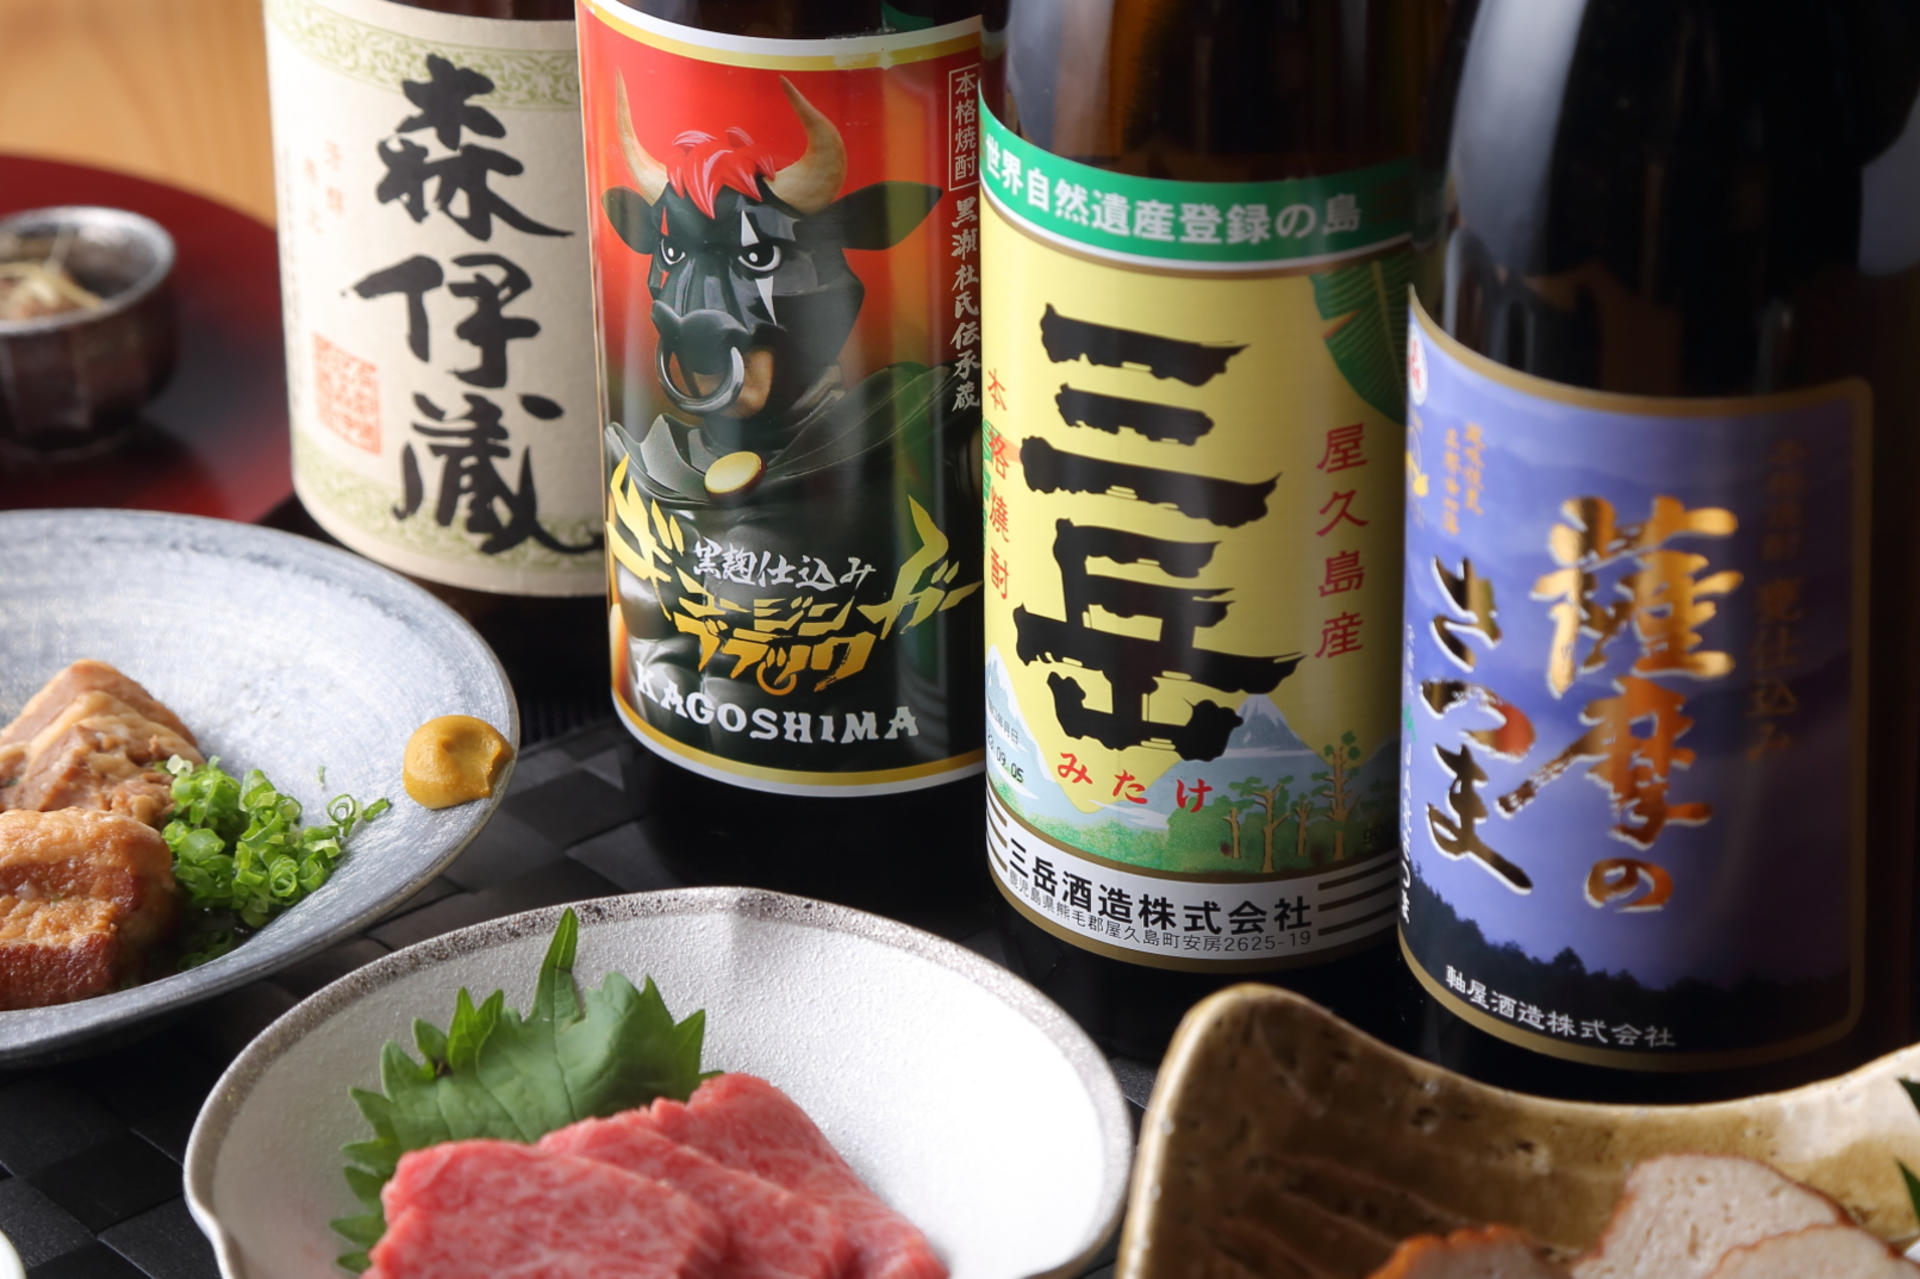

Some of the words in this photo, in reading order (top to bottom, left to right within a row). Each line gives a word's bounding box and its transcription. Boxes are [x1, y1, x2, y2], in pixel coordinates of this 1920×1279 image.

[954, 71, 977, 181] 本格焼酎
[985, 134, 1361, 246] 世界自然遺産登録の島
[1013, 303, 1308, 763] 三岳
[1315, 422, 1369, 660] 屋久島産
[636, 662, 919, 744] KAGOSHIMA
[1420, 556, 1534, 895] さつま
[1057, 752, 1213, 814] みたけ
[1008, 837, 1313, 935] 三岳酒造株式会社
[1446, 964, 1677, 1047] 軸屋酒造株式会社
